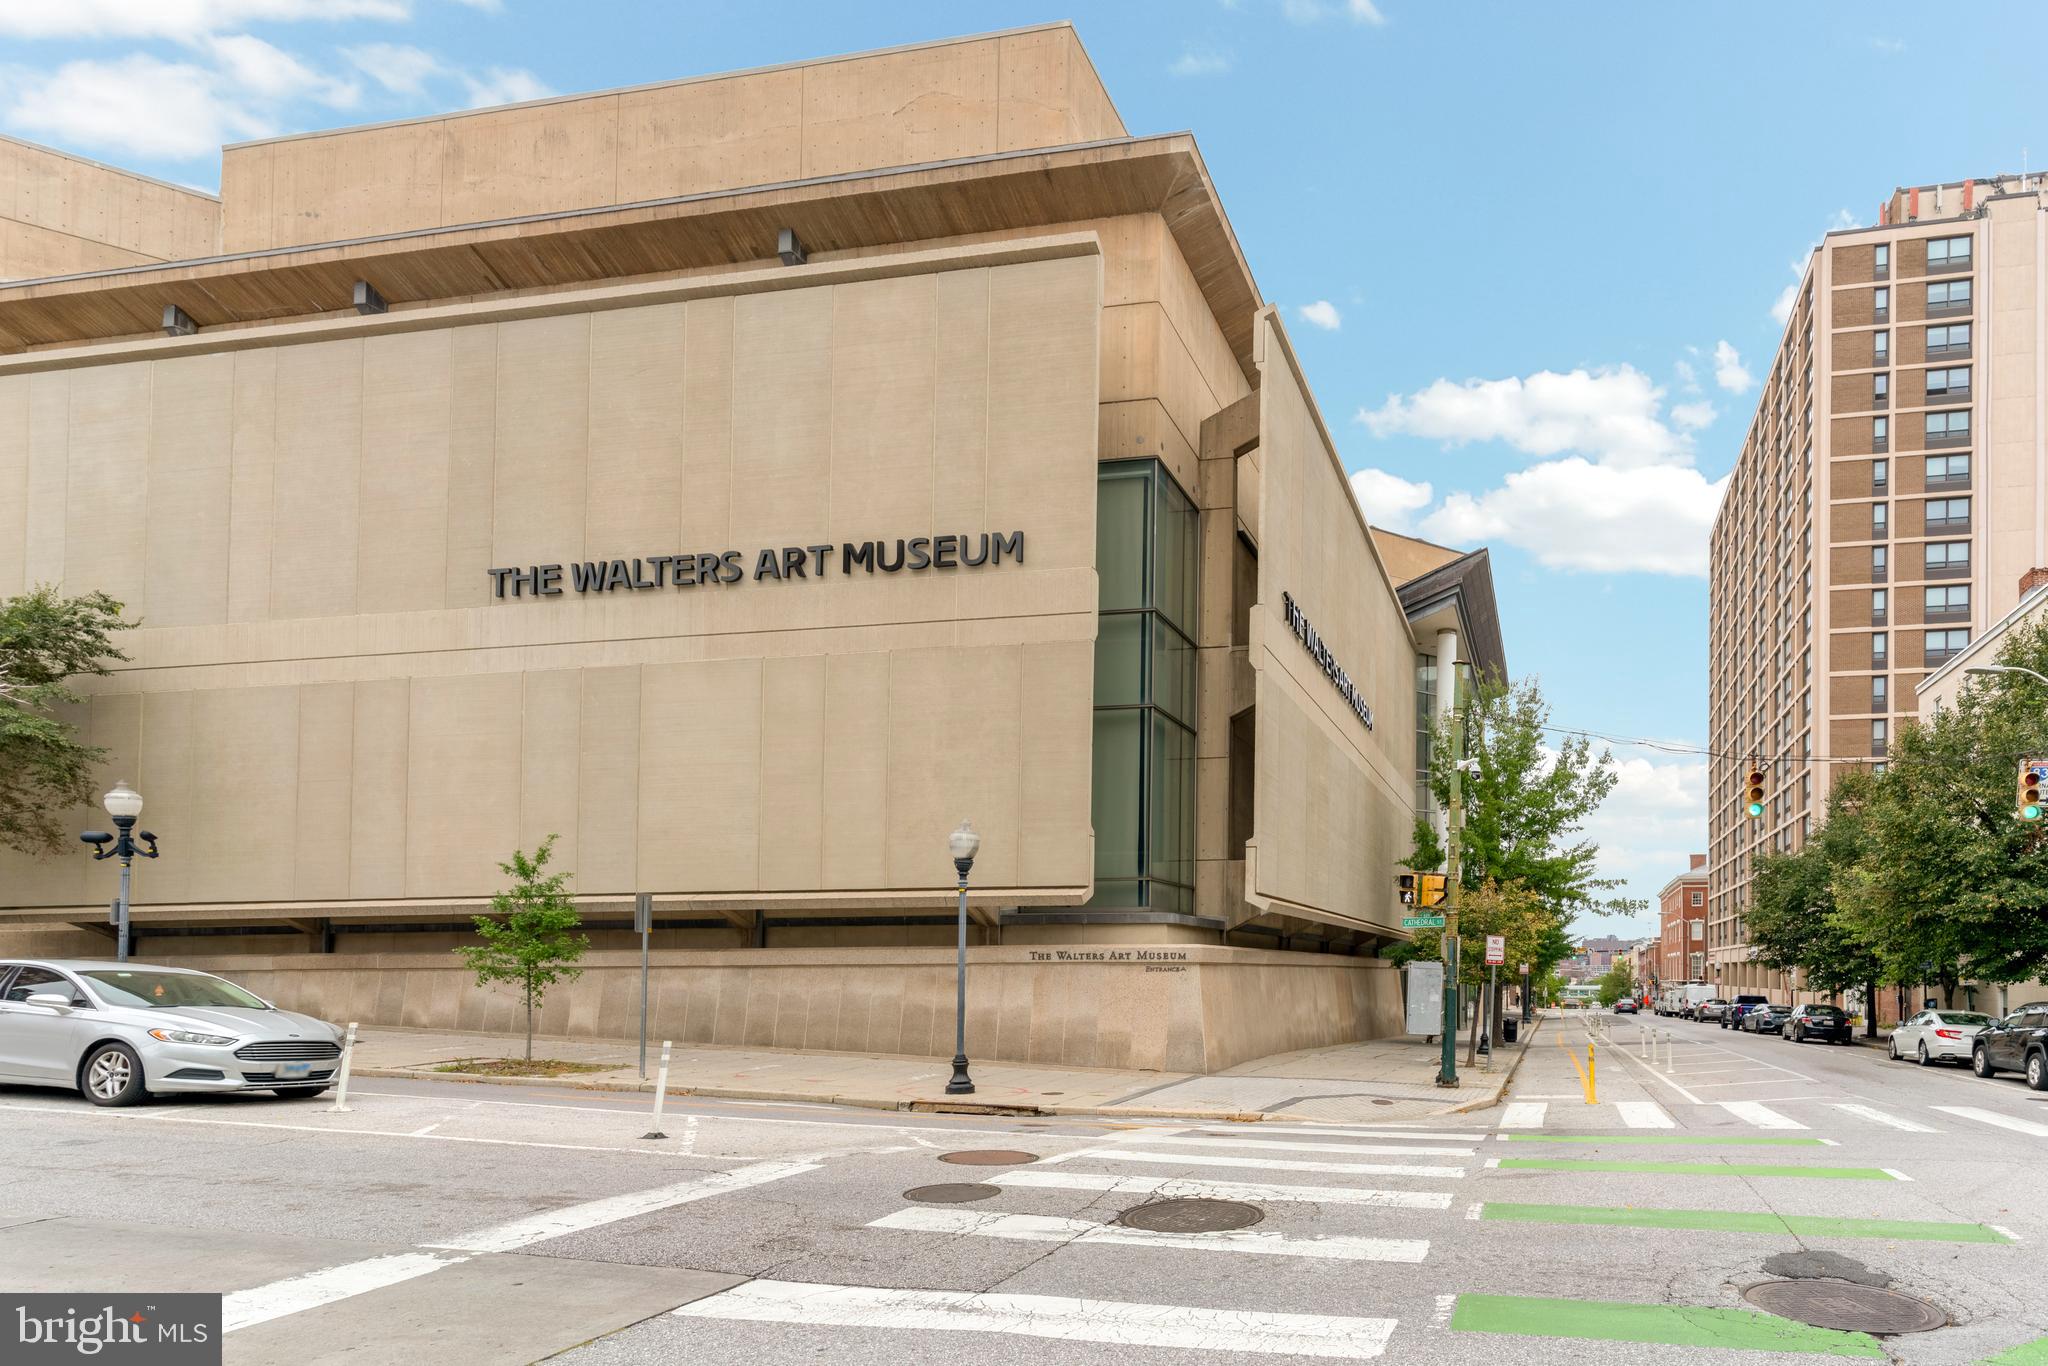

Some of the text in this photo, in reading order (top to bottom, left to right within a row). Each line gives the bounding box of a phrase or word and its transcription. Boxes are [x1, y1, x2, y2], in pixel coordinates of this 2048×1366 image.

[488, 530, 1025, 598] THE WALTERS ART MUSEUM
[1404, 918, 1436, 926] CATHEDRAL
